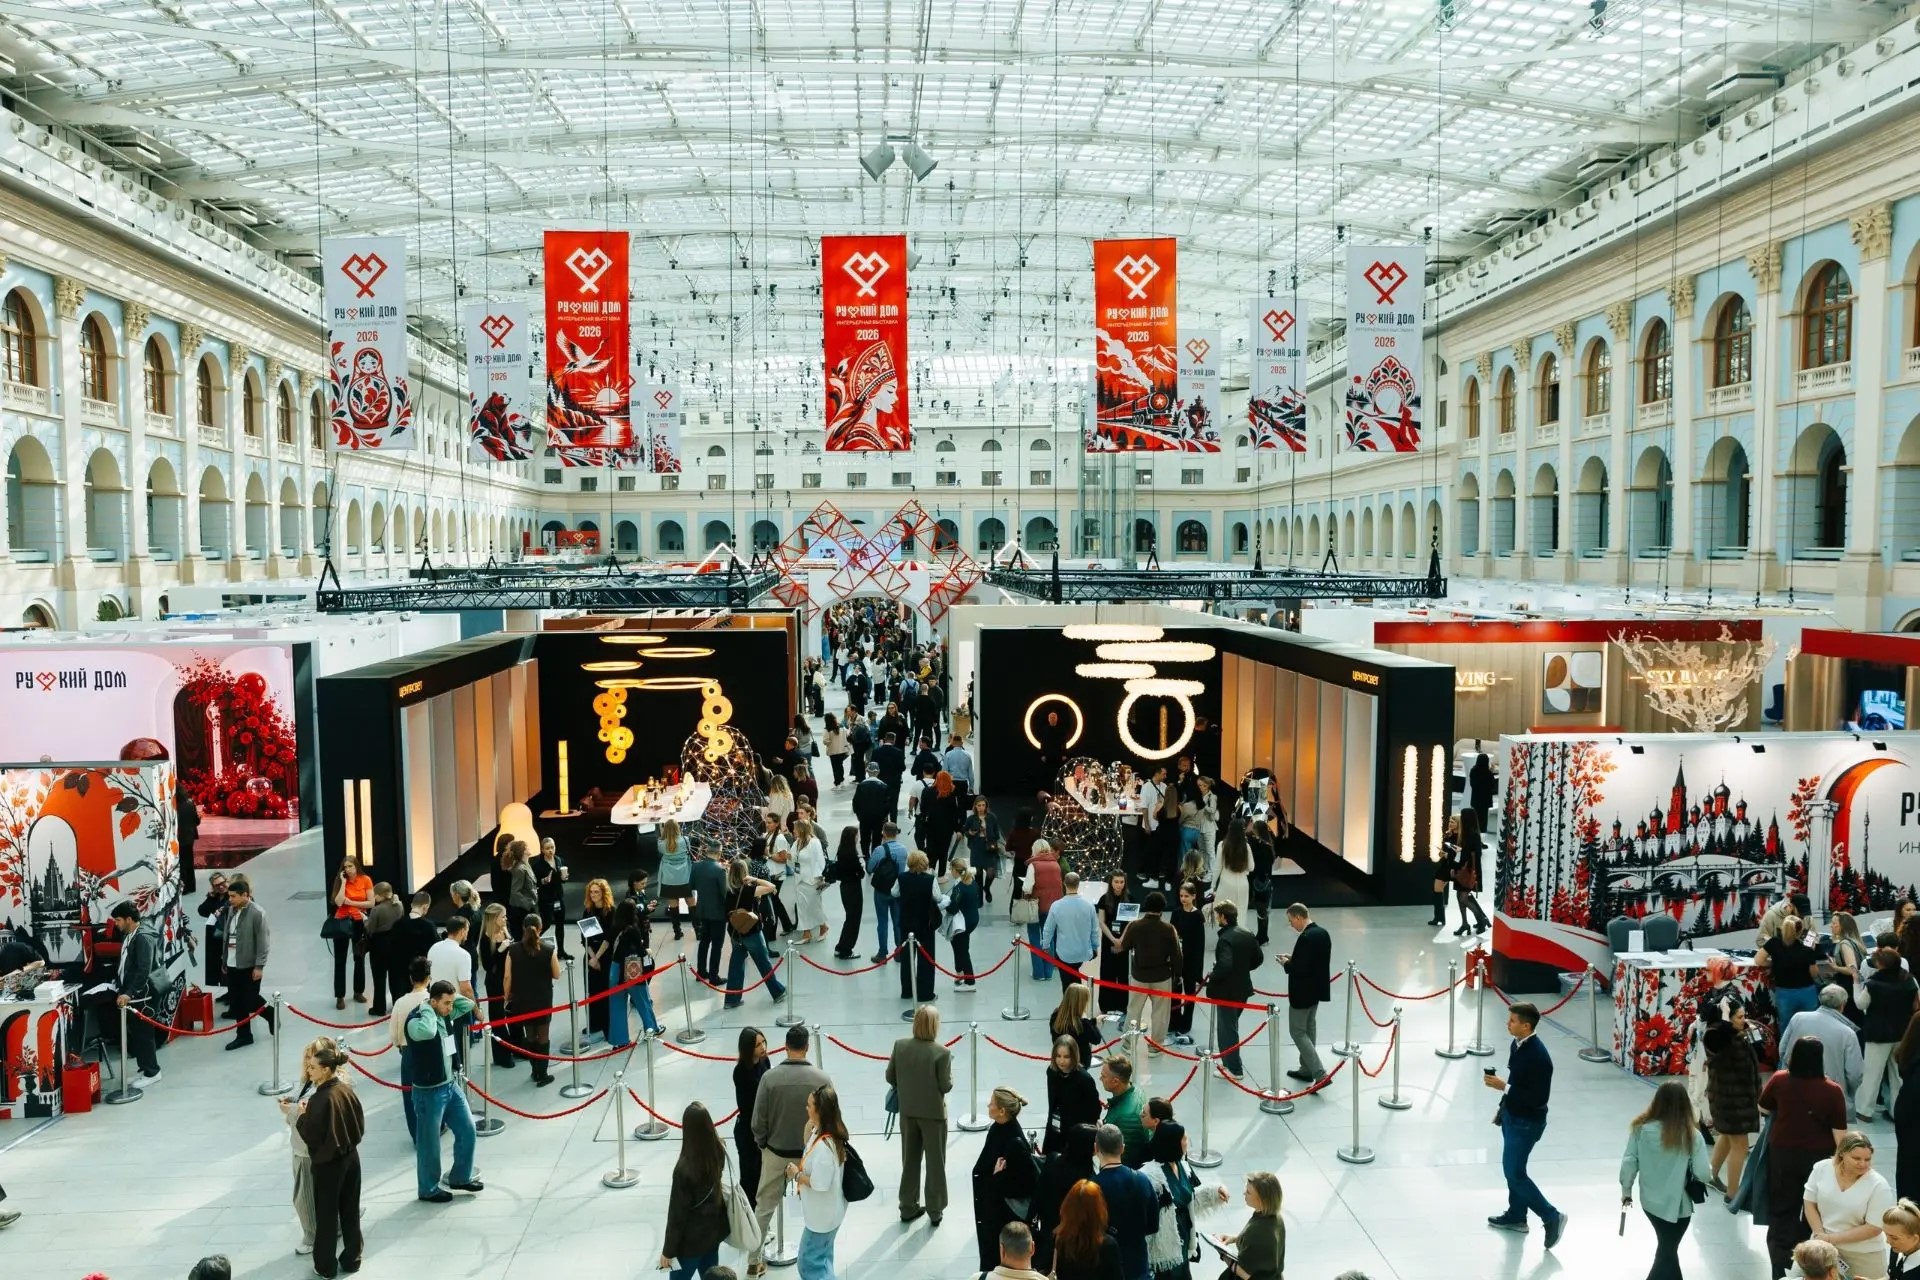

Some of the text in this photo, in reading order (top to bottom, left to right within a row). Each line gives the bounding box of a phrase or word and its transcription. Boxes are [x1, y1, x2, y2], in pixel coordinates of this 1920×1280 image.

[379, 306, 397, 317] ДОМ
[602, 300, 621, 314] ДОМ
[880, 305, 898, 318] ДОМ
[1150, 306, 1169, 320] ДОМ
[1397, 313, 1415, 325] ДОМ
[357, 332, 378, 342] 2026
[579, 326, 601, 337] 2026
[857, 330, 879, 341] 2026
[1127, 331, 1150, 343] 2026
[1374, 336, 1396, 349] 2026
[508, 354, 521, 362] ДОМ
[491, 373, 506, 381] 2026
[94, 670, 127, 691] ДОМ
